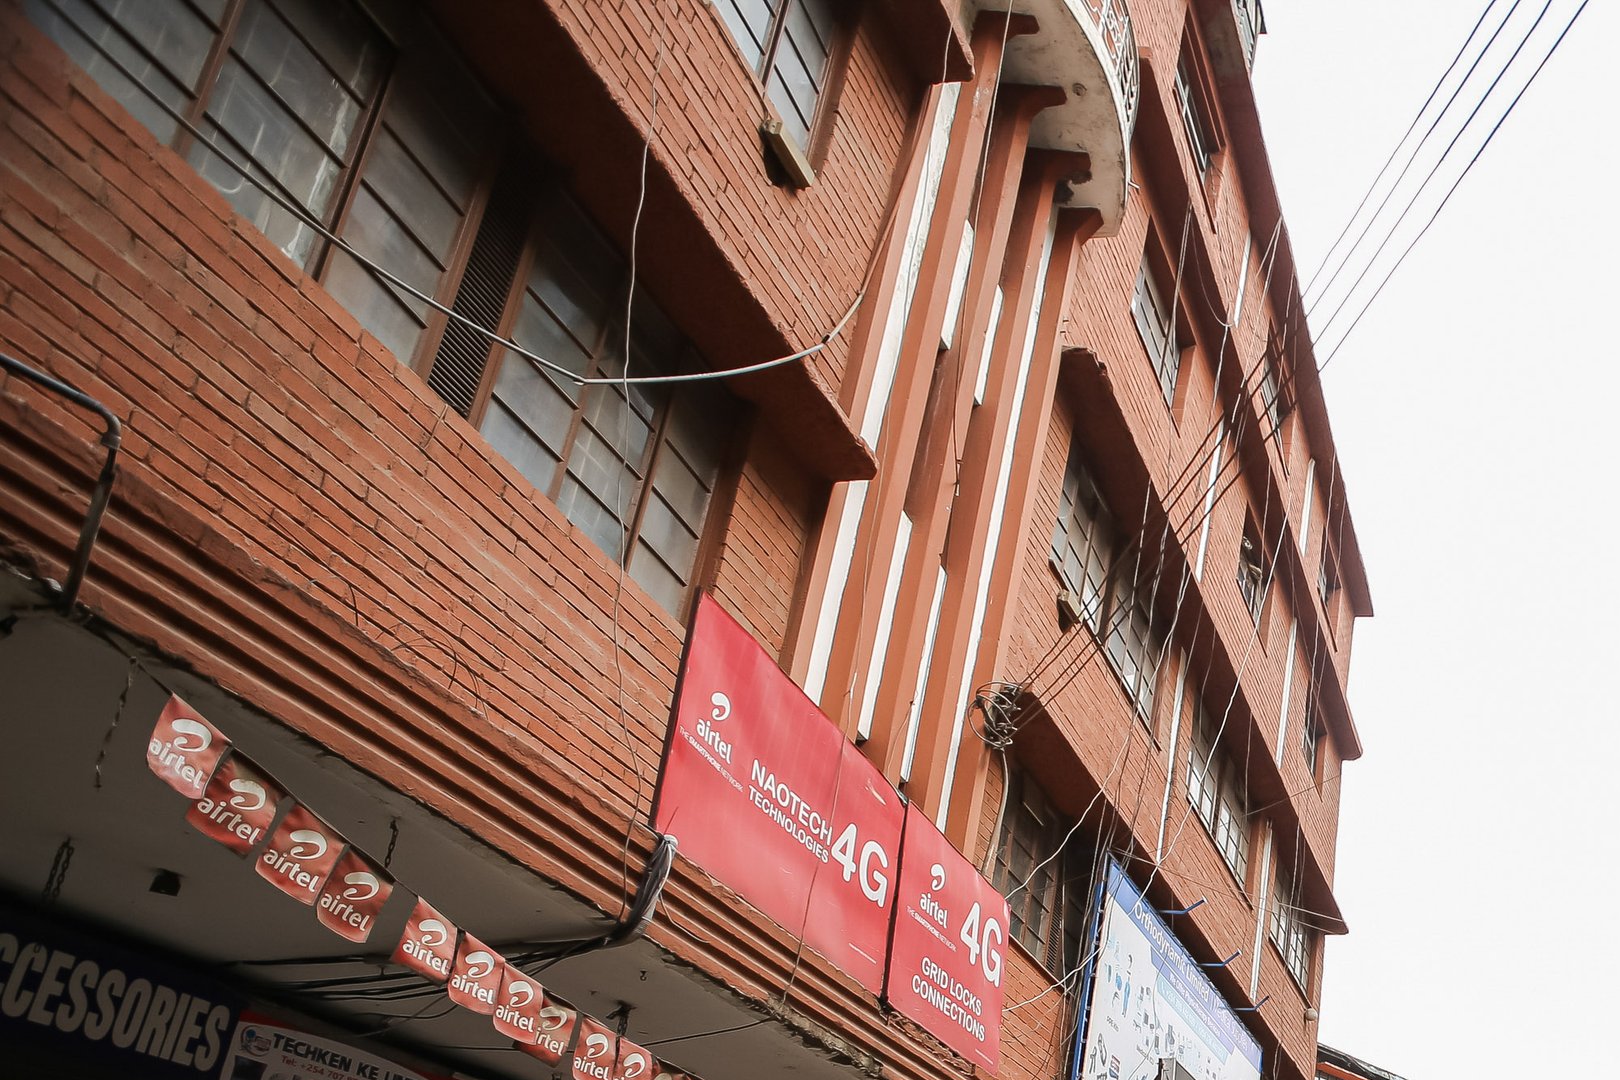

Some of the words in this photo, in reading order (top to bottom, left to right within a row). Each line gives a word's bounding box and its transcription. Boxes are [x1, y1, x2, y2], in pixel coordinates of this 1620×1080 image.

[149, 738, 203, 789] airtel
[697, 719, 732, 764] airtel
[198, 798, 259, 844] airtel
[749, 785, 829, 863] TECHNOLOGIES
[751, 759, 832, 846] NAOTECH
[263, 849, 318, 893] airtel
[831, 823, 888, 908] 4G
[321, 893, 371, 931] airtel
[920, 893, 947, 929] airtel
[402, 938, 449, 975] airtel
[960, 902, 1002, 987] 4G
[451, 975, 493, 1005] airtel
[921, 957, 948, 989] GRID
[949, 978, 982, 1016] LOCKS
[1185, 971, 1211, 1000] Limited
[495, 1005, 533, 1032] airtel
[912, 975, 985, 1042] CONNECTIONS
[272, 1033, 352, 1073] TECHKEN
[356, 1061, 379, 1080] KE
[574, 1056, 609, 1080] airtel
